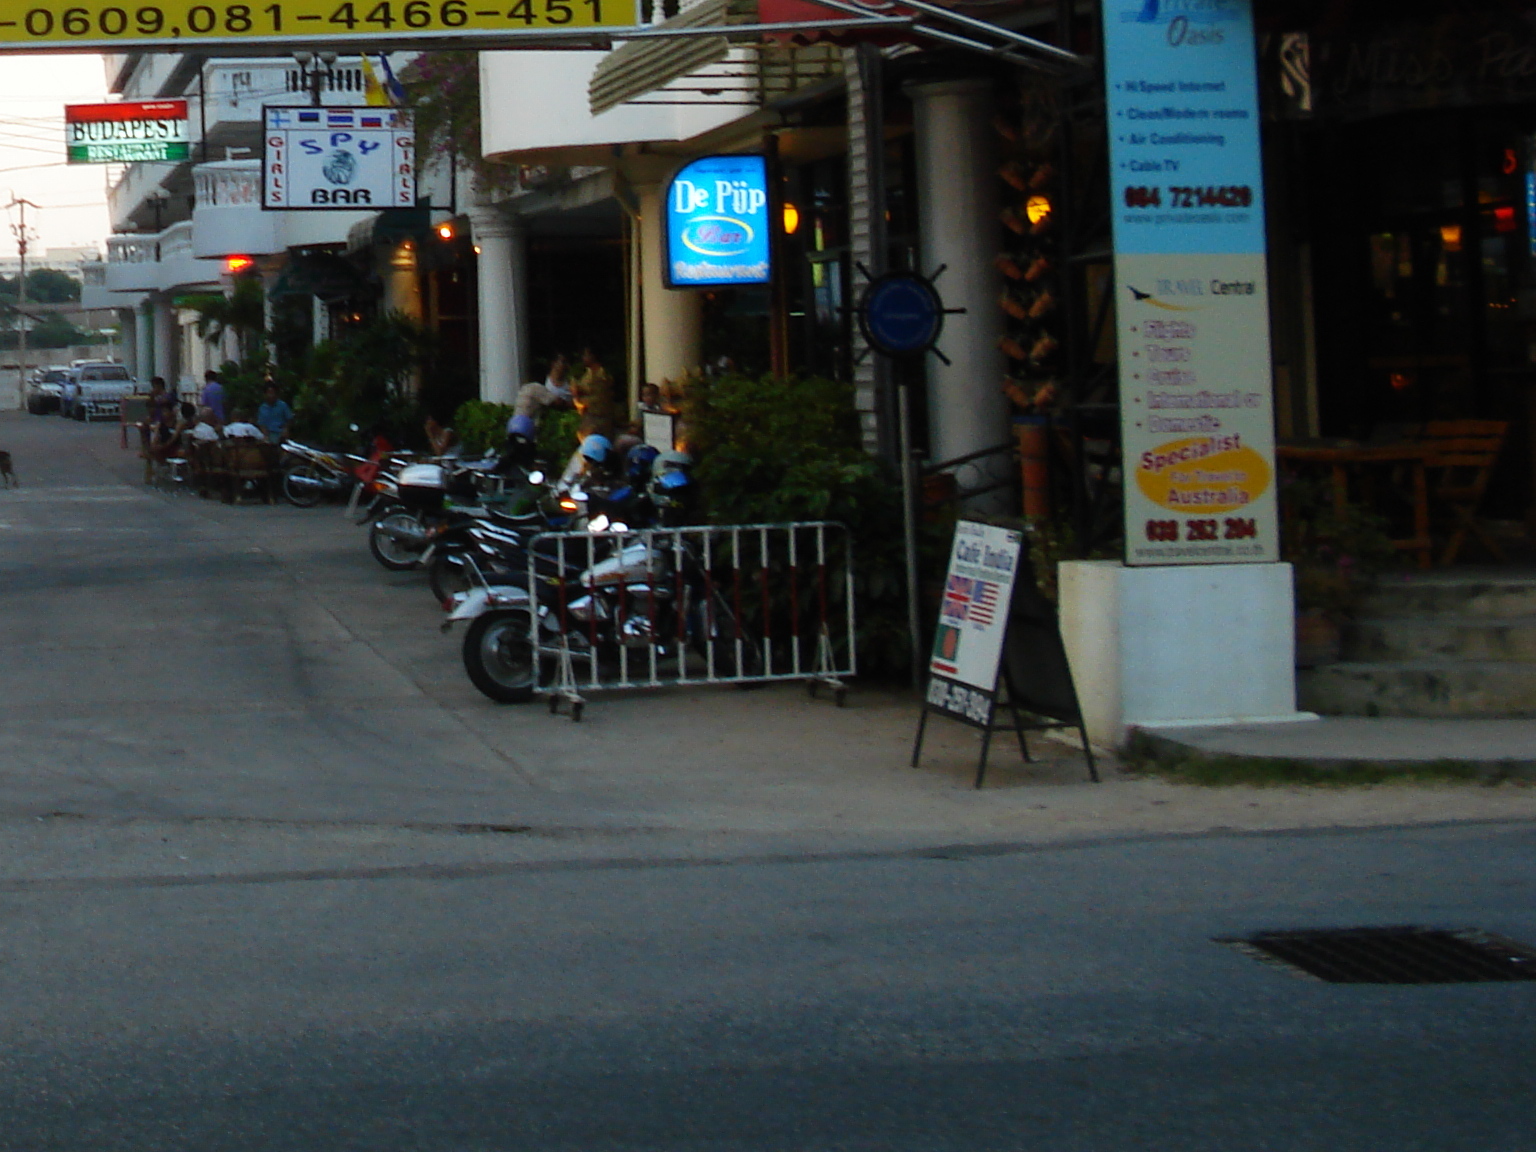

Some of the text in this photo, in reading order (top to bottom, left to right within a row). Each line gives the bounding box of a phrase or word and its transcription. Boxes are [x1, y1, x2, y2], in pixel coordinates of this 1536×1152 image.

[1167, 14, 1225, 47] Oasis
[71, 116, 183, 142] BUDAPEST
[299, 132, 381, 156] SPY
[268, 136, 285, 203] GIRLS
[395, 136, 414, 203] GIRLS
[1129, 159, 1180, 172] Cable TV
[311, 188, 372, 205] BAR
[673, 179, 710, 214] De
[1210, 278, 1256, 296] Central
[1141, 431, 1241, 473] Specialist
[1168, 488, 1250, 505] Australia
